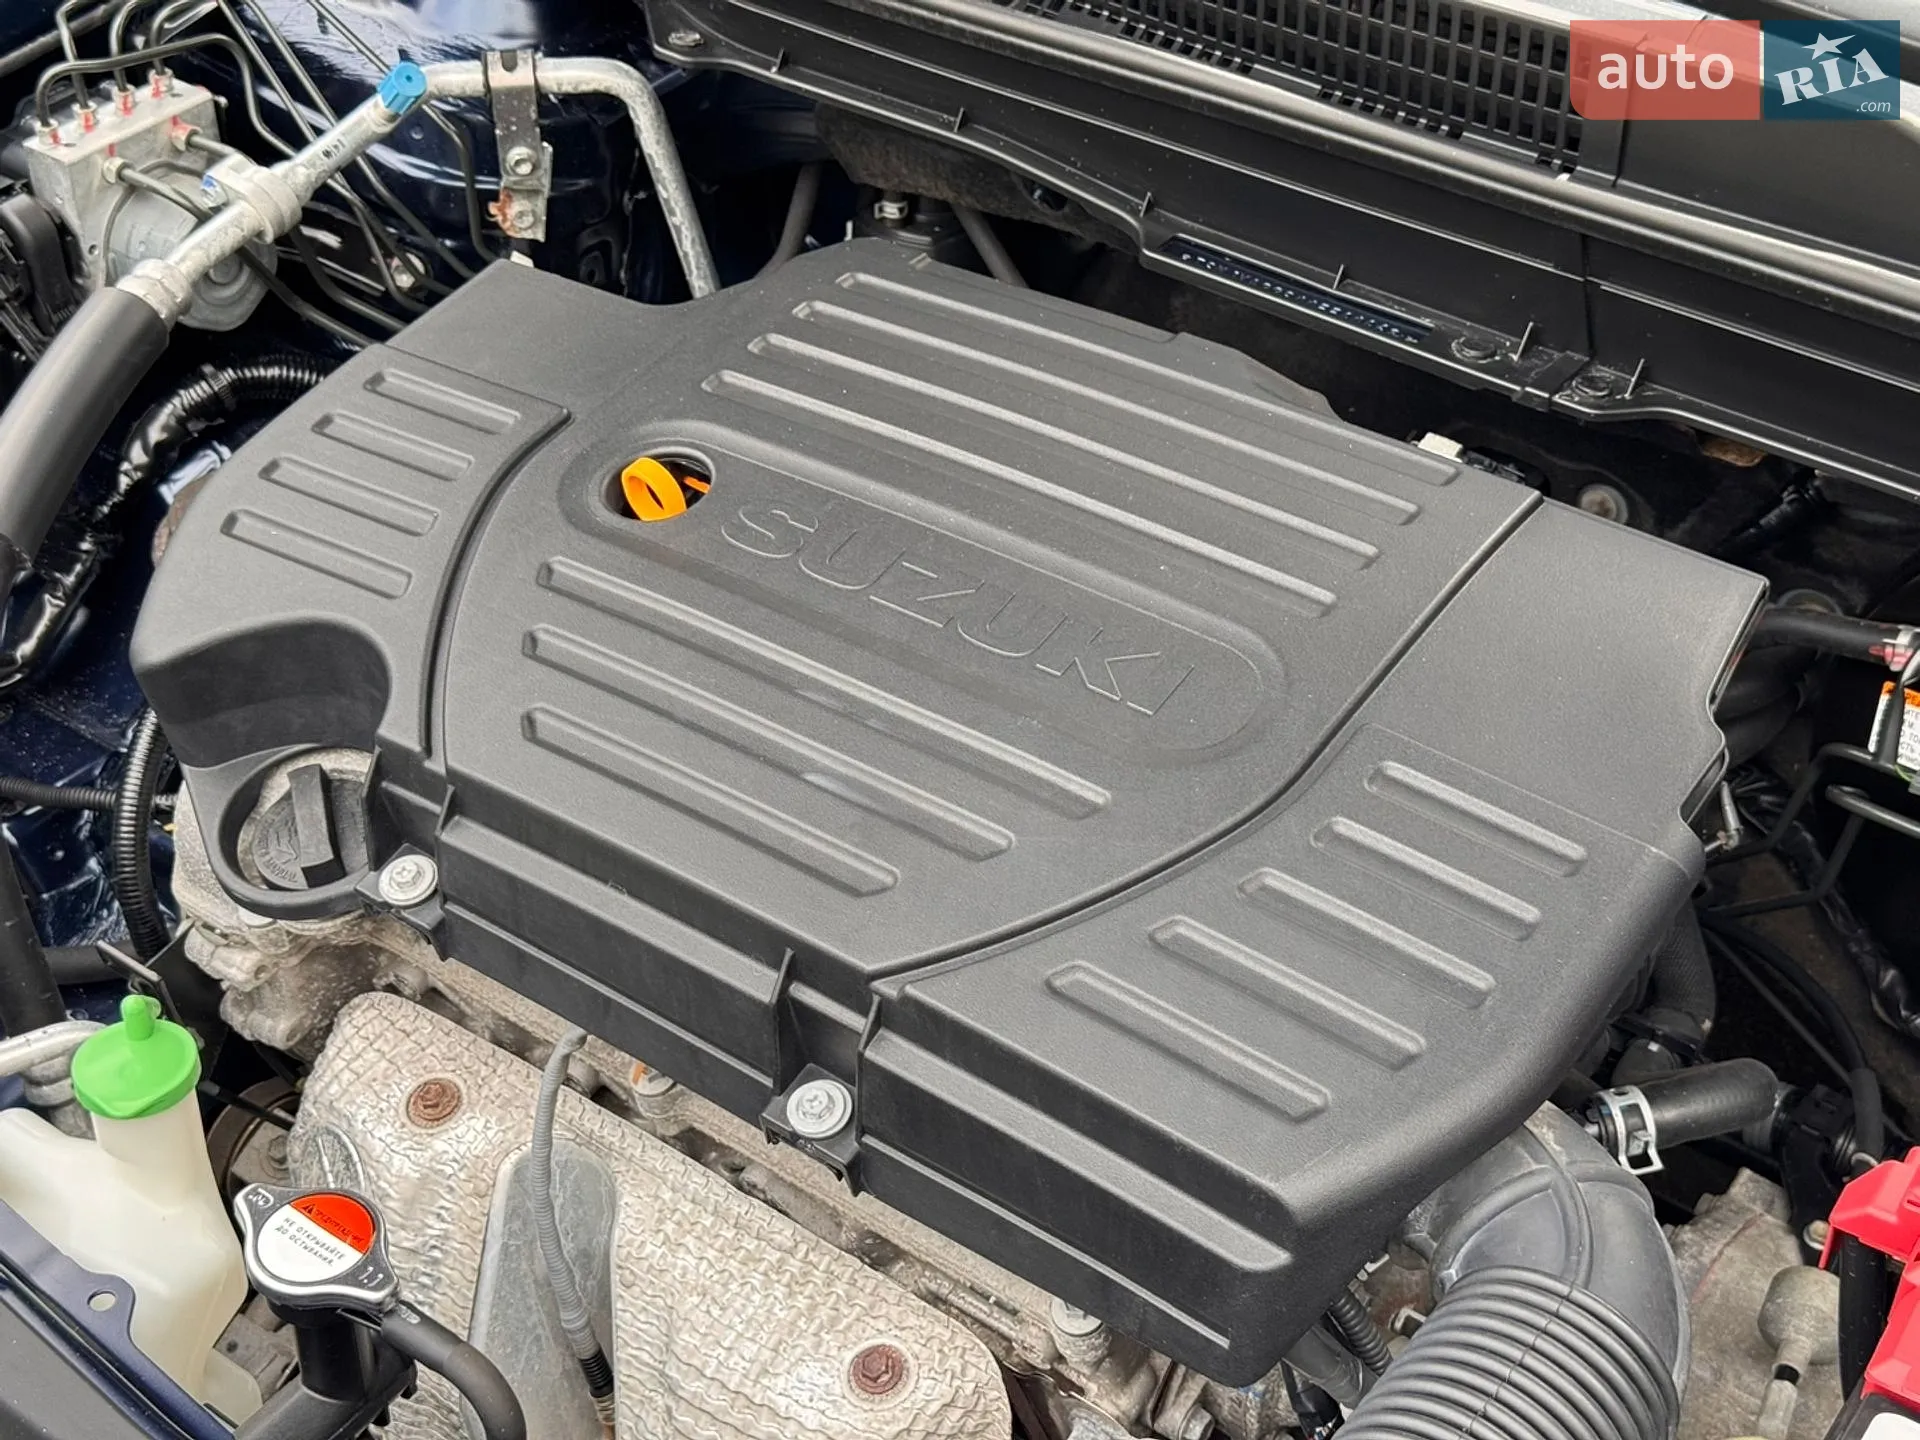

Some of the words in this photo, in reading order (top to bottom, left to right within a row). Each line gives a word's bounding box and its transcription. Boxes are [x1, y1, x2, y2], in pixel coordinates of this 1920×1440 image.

[721, 504, 1194, 716] SUZUKI
[284, 1217, 296, 1228] НЕ
[274, 1224, 288, 1236] ДО
